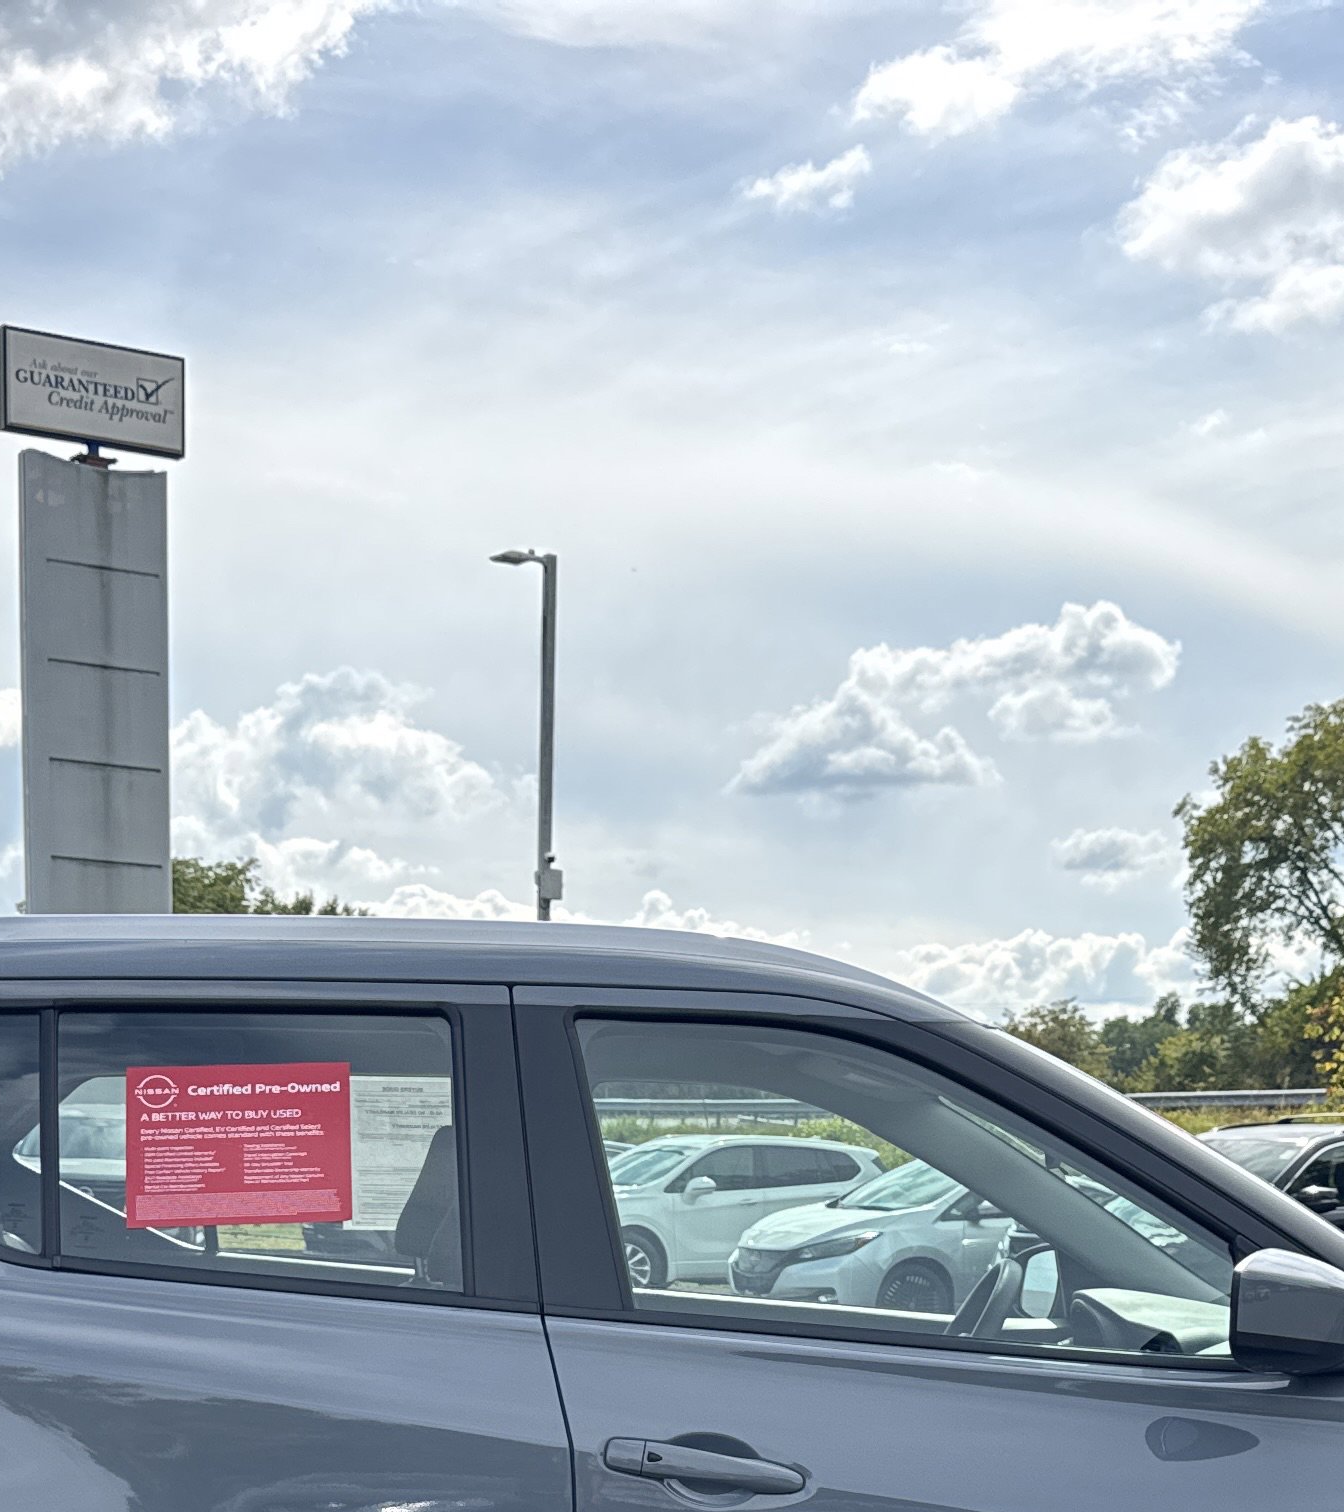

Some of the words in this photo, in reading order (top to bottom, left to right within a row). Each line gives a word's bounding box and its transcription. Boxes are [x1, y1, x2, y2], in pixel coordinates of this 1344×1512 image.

[30, 359, 47, 370] Ask
[50, 362, 78, 375] about
[15, 368, 135, 401] GUARANTEED
[48, 390, 95, 412] Credit
[97, 400, 168, 424] Approval
[134, 1087, 179, 1095] NISSAN
[187, 1083, 252, 1096] Certified
[255, 1081, 341, 1094] Pre-Owned
[140, 1113, 149, 1122] A
[151, 1112, 197, 1122] BETTER
[198, 1111, 223, 1121] WAY
[225, 1110, 242, 1120] TO
[244, 1109, 269, 1119] BUY
[271, 1108, 302, 1118] USED
